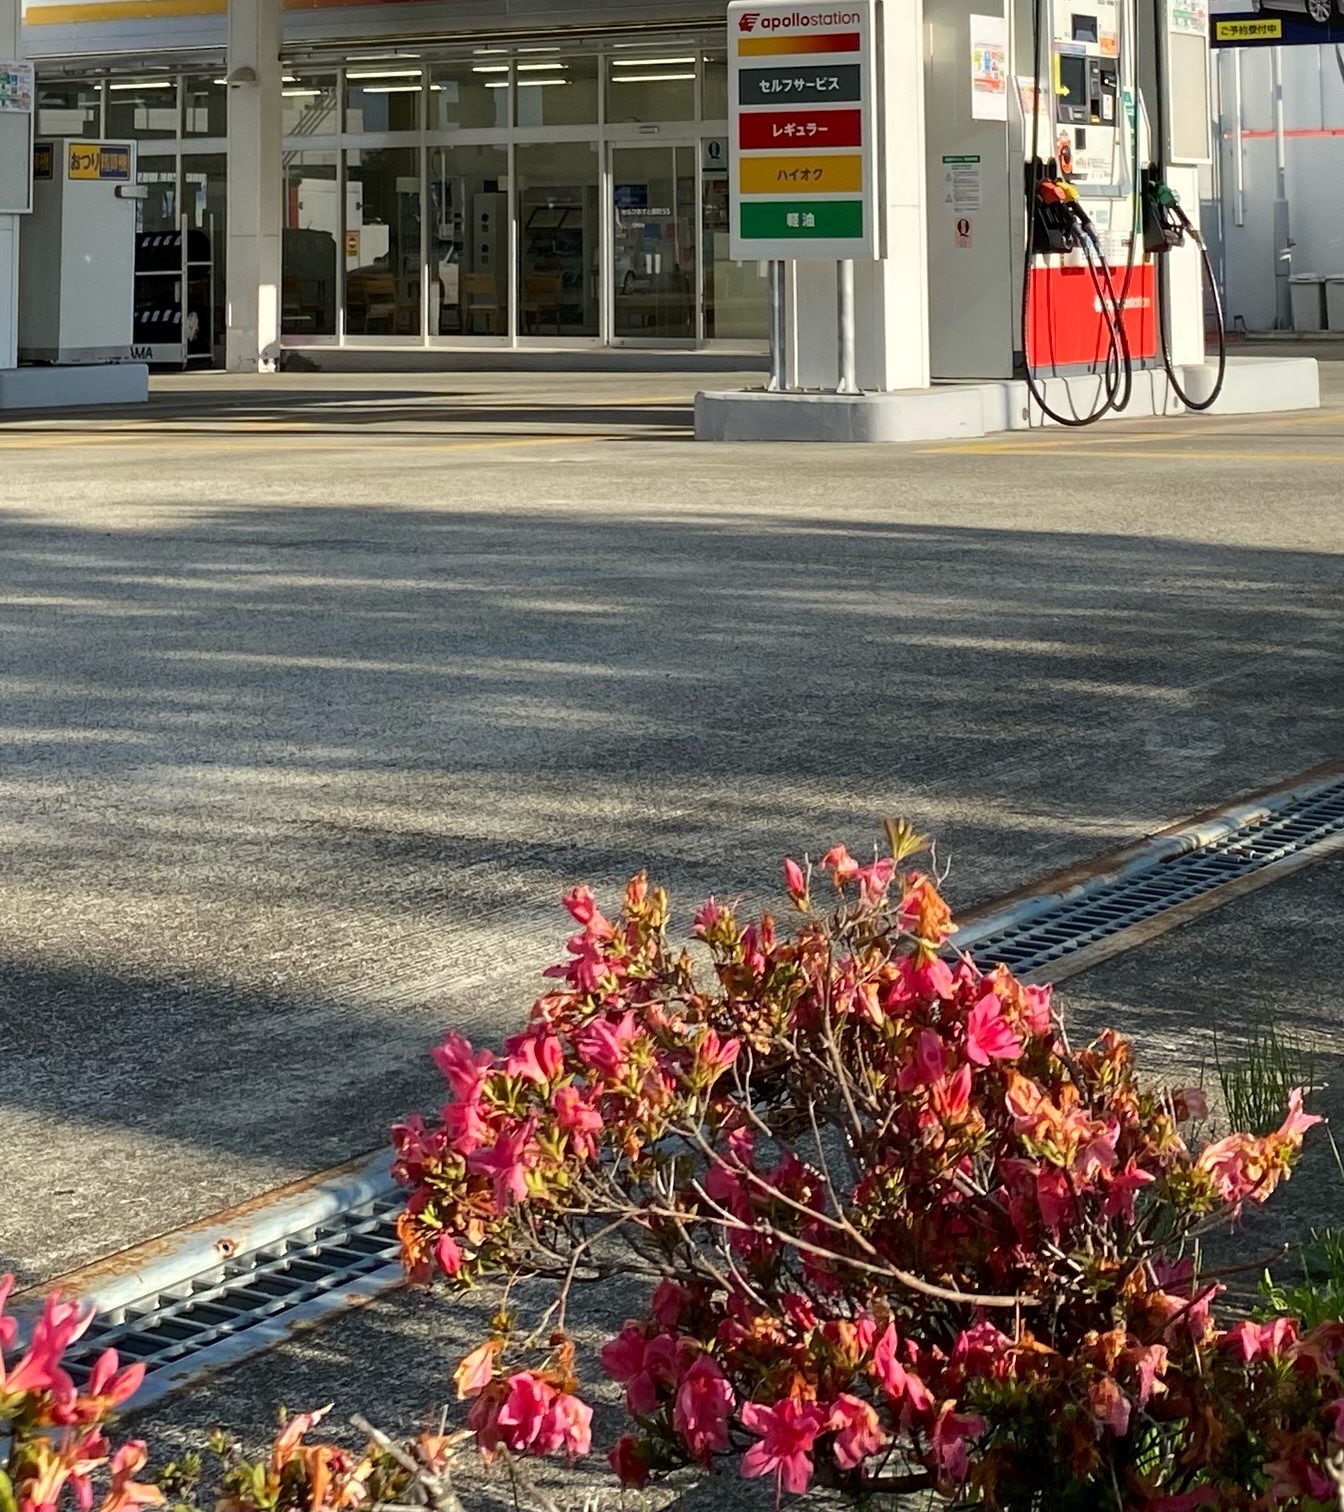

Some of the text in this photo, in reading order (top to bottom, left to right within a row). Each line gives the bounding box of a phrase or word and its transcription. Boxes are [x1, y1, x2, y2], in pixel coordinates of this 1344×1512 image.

[761, 11, 861, 31] apollostation
[759, 76, 840, 93] セルフサービス
[772, 122, 829, 138] レギュラー
[70, 151, 100, 171] おつり
[776, 168, 824, 182] ハイオク
[786, 212, 816, 228] 軽油
